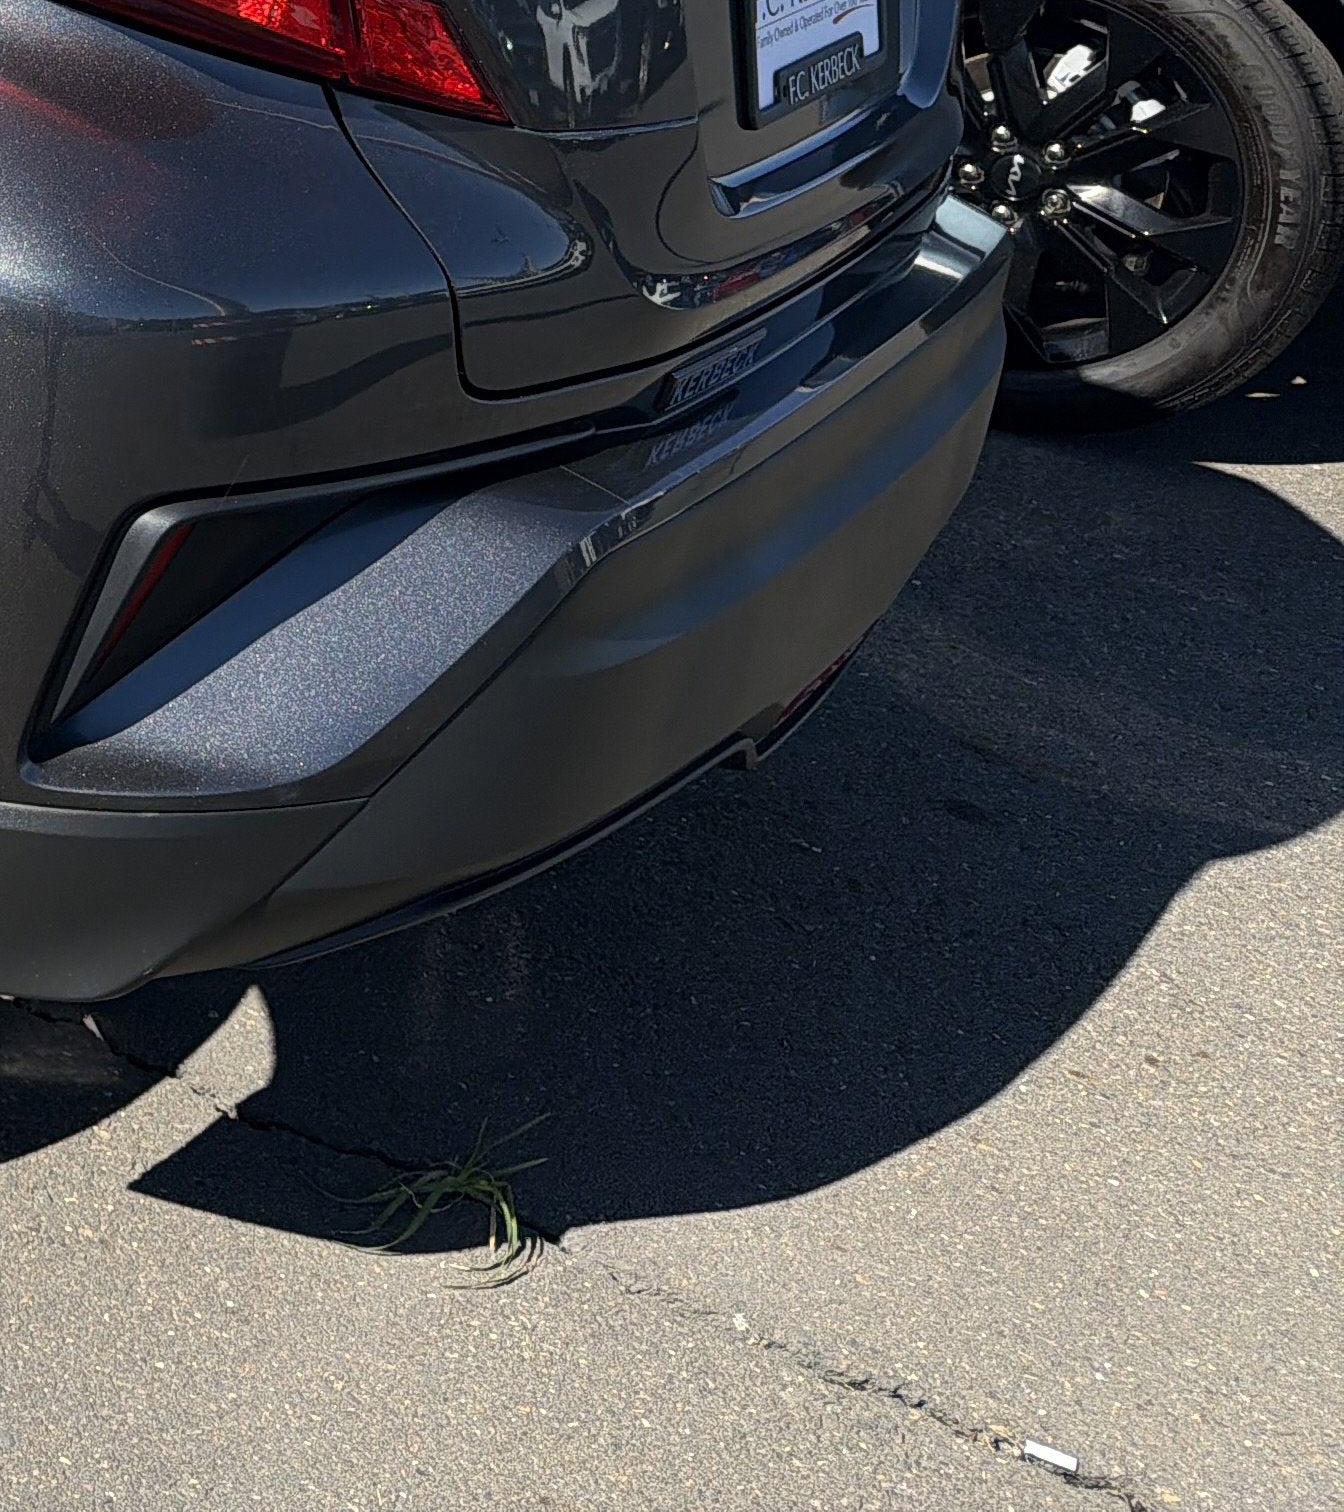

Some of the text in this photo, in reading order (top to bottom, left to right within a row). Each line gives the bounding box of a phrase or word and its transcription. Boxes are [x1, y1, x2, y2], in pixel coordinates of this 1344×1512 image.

[773, 20, 794, 43] Owned
[799, 8, 825, 31] Operated
[787, 43, 862, 106] F.C. KERBECK
[668, 341, 762, 407] KERBECK
